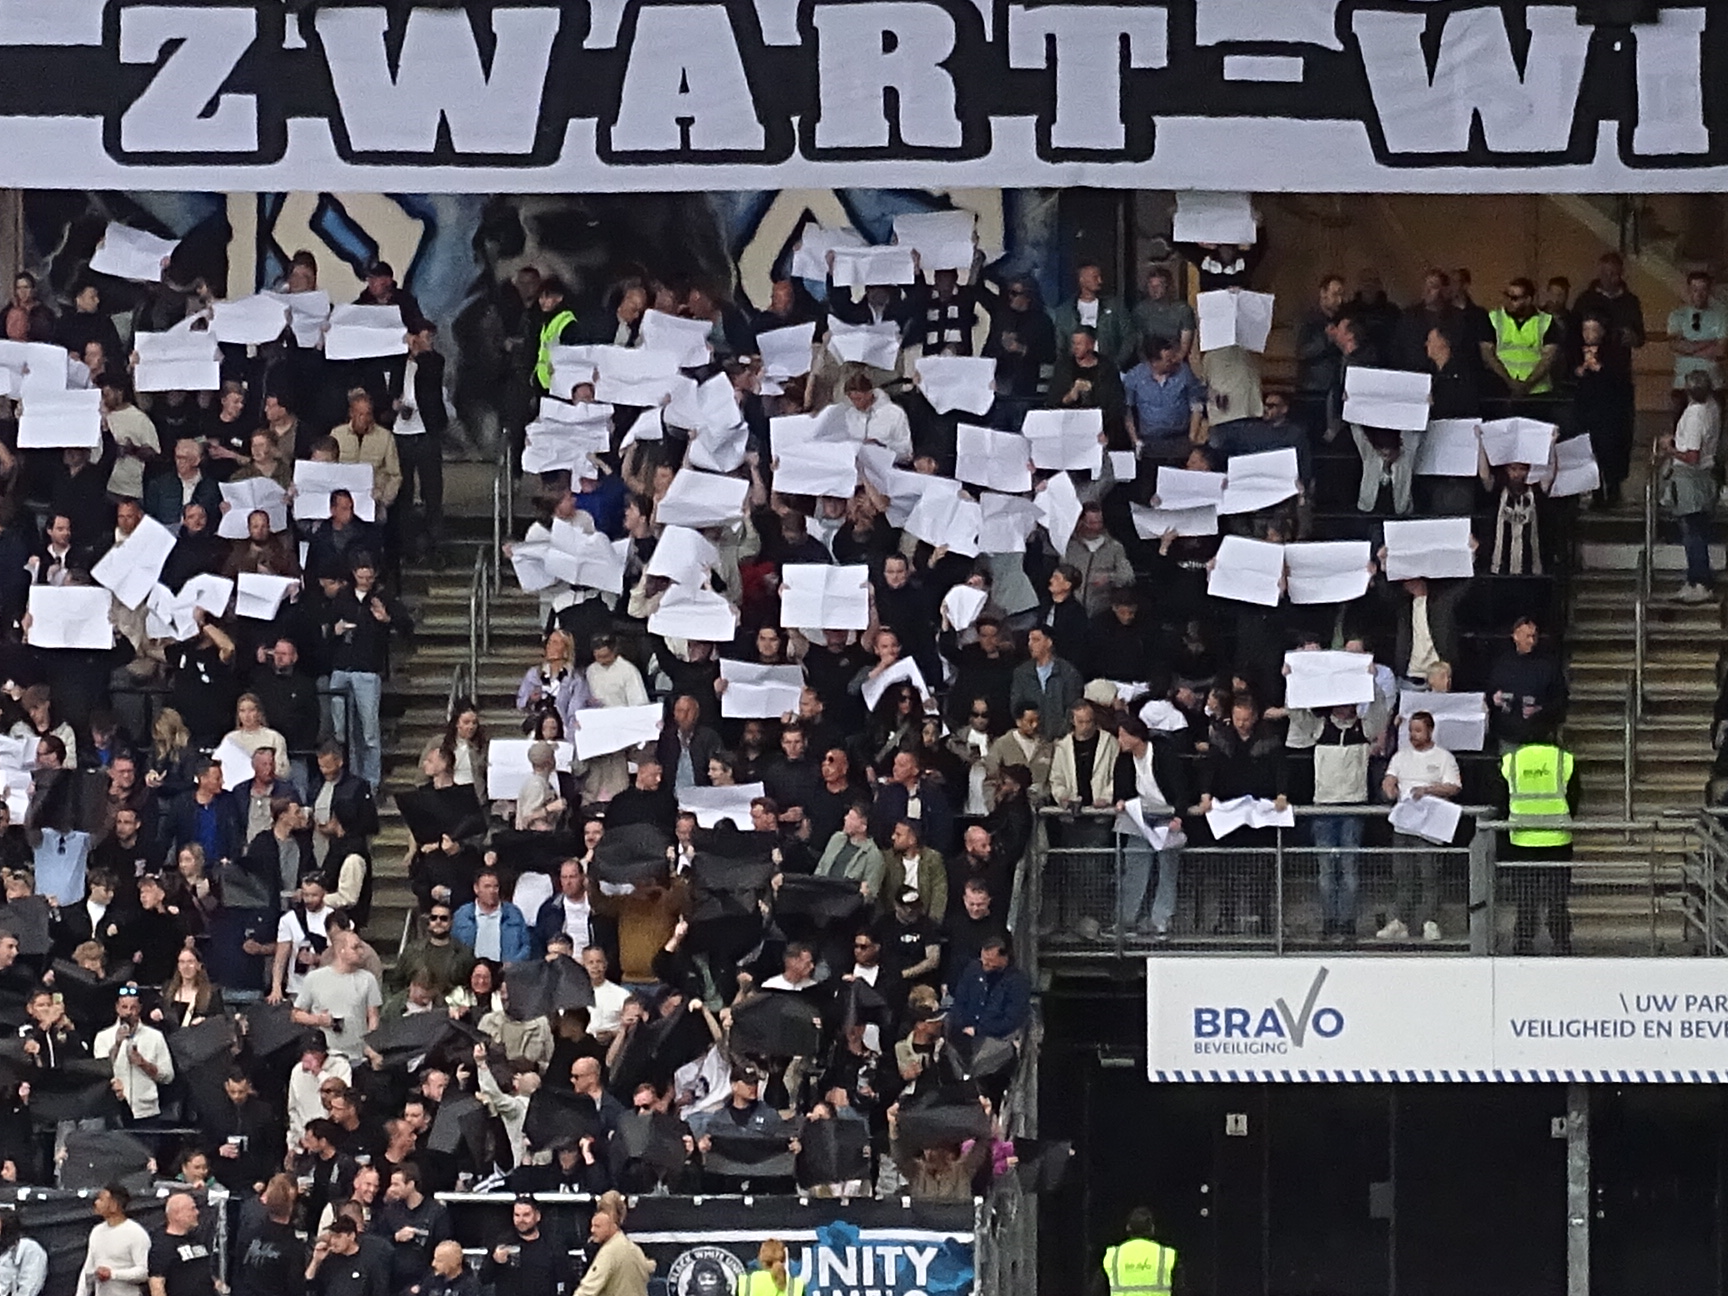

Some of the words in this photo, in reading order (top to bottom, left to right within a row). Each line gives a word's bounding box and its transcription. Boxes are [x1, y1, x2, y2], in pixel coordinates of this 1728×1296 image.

[1193, 965, 1345, 1049] BRAVO
[1635, 994, 1678, 1013] UW
[1510, 1018, 1636, 1037] VEILIGHEID
[1643, 1020, 1672, 1038] EN
[1193, 1041, 1288, 1055] BEVEILIGING
